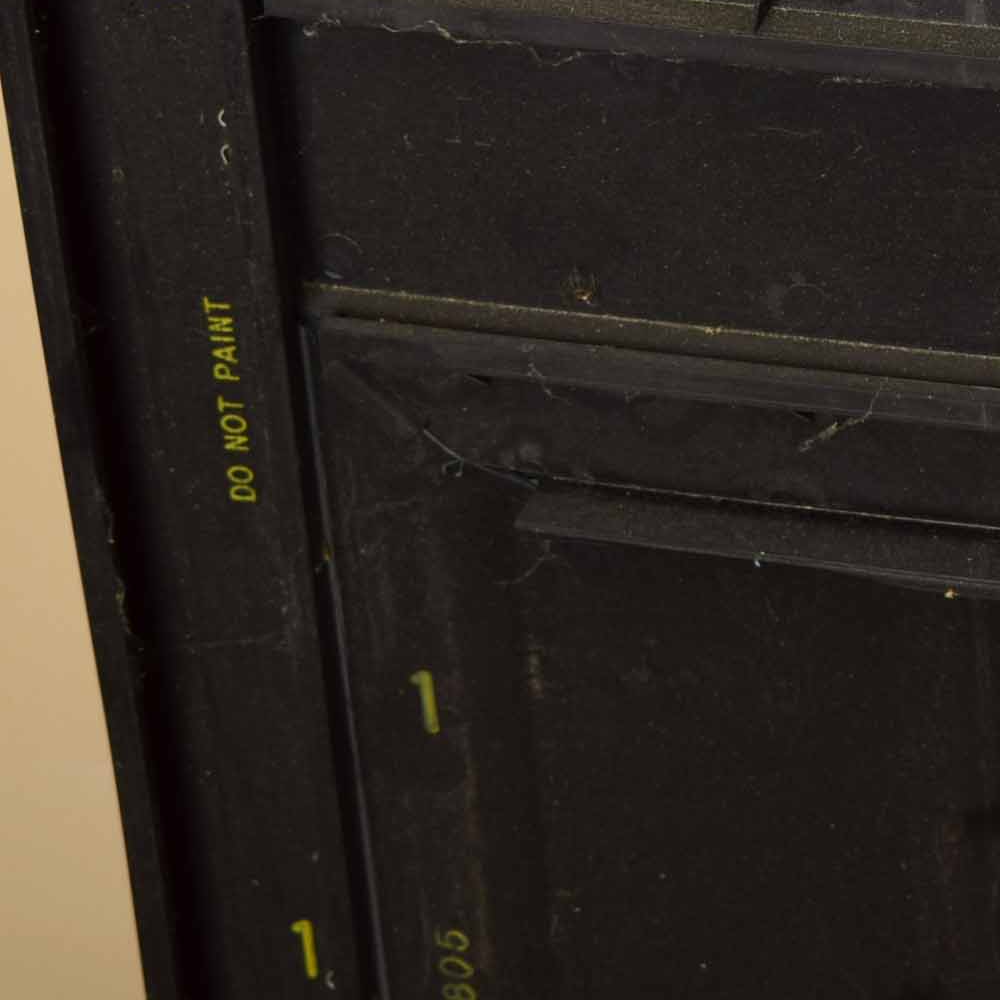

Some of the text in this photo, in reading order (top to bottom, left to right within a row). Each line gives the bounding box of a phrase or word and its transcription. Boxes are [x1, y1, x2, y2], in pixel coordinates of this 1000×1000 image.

[201, 295, 258, 504] DO NOT PAINT
[409, 668, 442, 736] 1
[291, 919, 319, 980] 1
